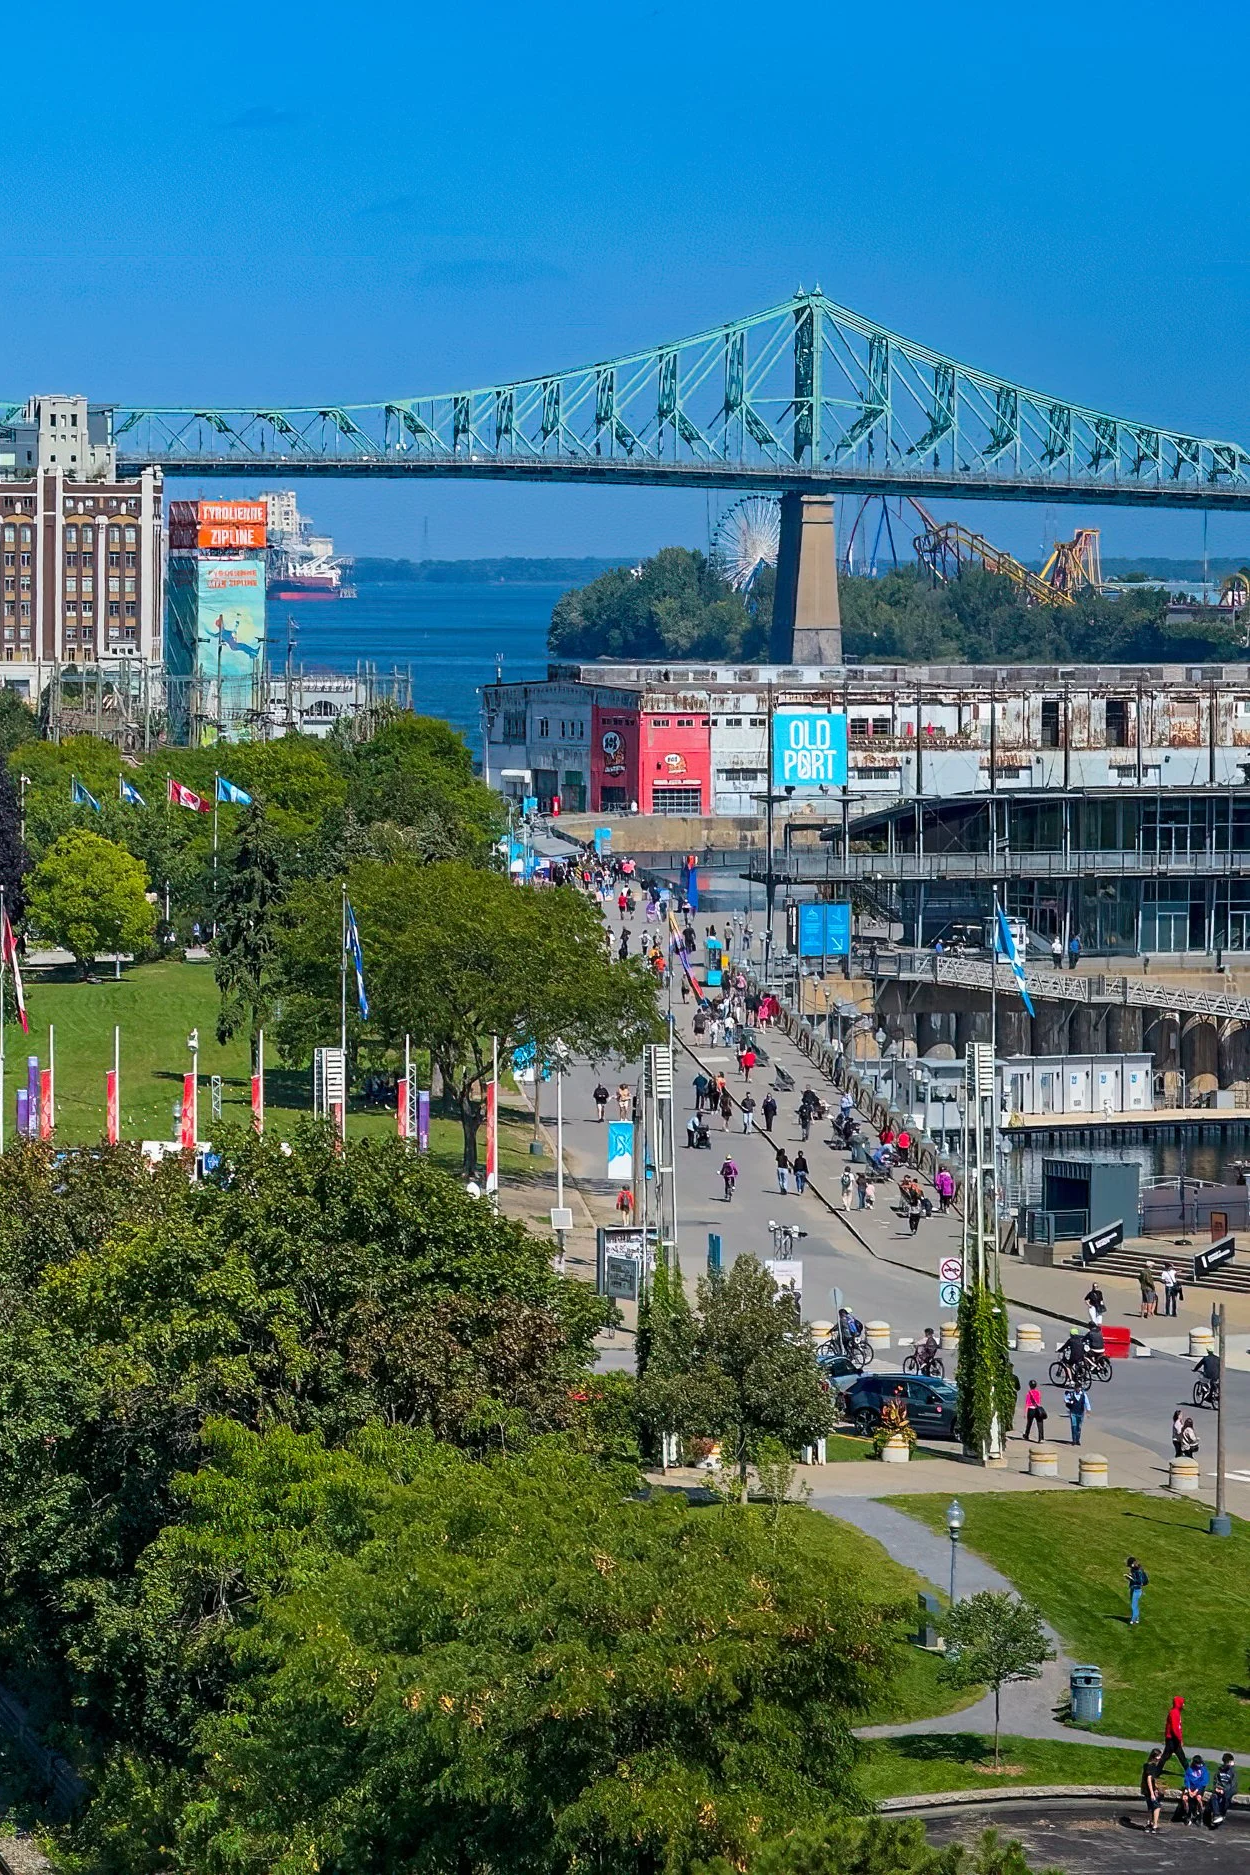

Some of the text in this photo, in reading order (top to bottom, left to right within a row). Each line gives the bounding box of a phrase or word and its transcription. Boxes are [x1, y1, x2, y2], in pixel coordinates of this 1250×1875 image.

[203, 506, 263, 521] TYROLIENNE
[211, 529, 255, 545] ZIPLINE
[790, 719, 831, 750] OLD
[784, 749, 838, 780] PORT
